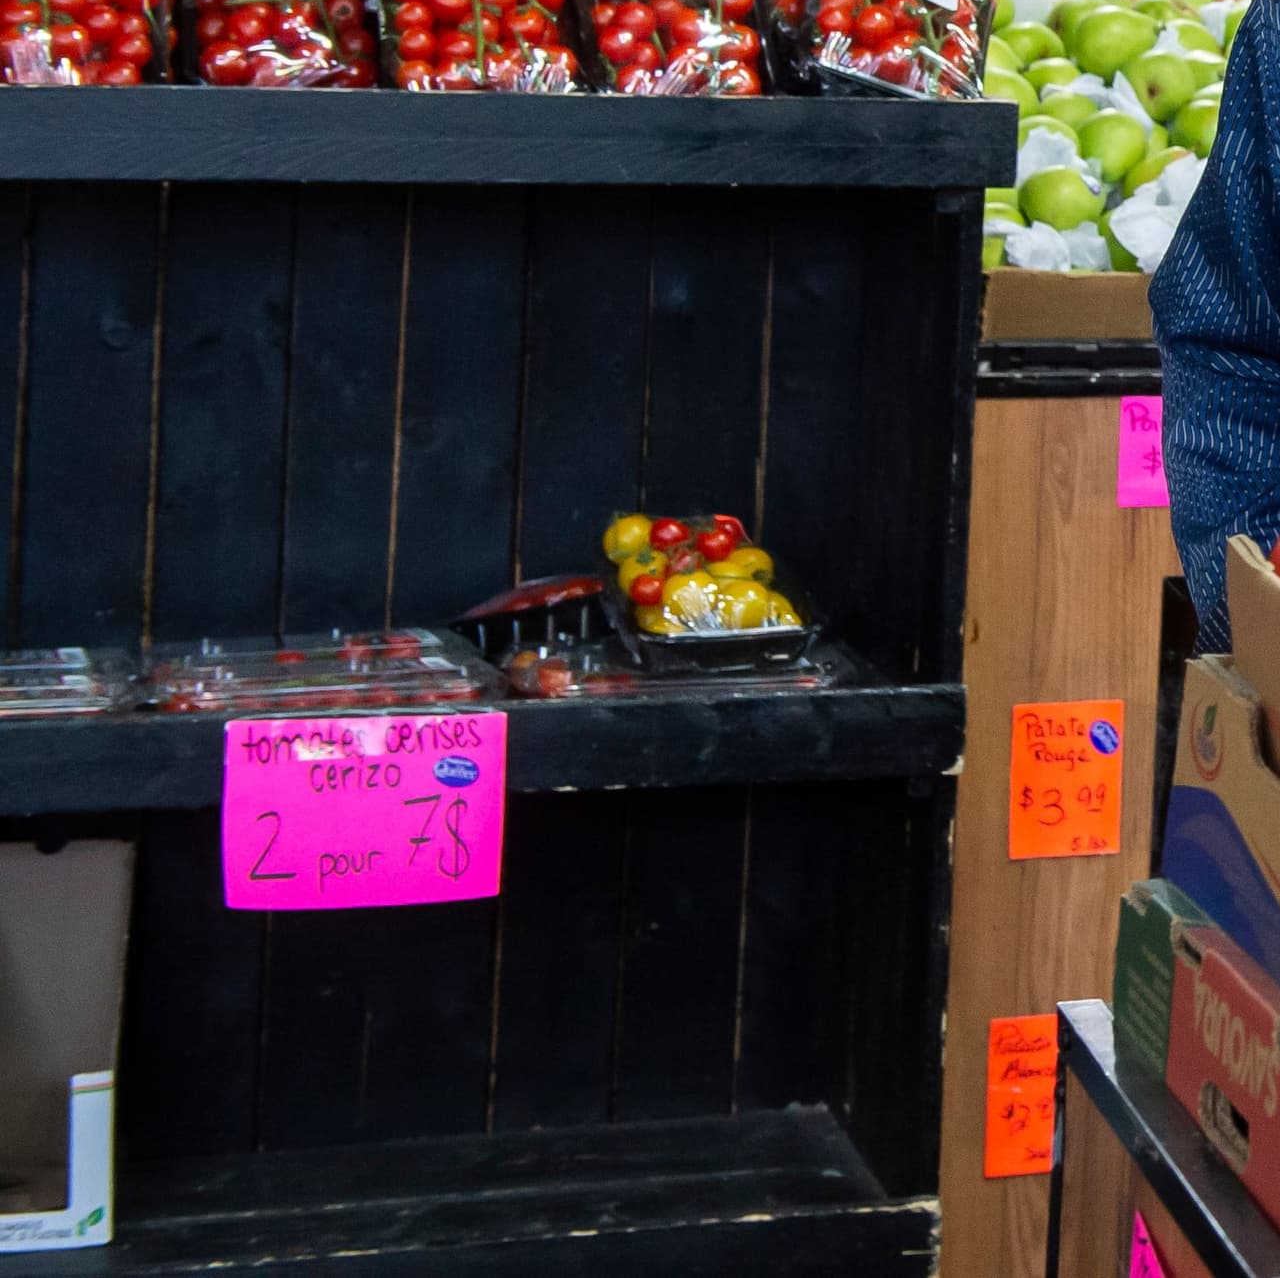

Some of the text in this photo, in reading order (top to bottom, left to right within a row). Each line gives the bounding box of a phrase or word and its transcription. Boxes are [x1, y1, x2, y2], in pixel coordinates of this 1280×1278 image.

[242, 718, 482, 763] tomates cerises
[309, 763, 401, 792] cerizo
[250, 811, 297, 880] 2
[319, 850, 383, 893] pour
